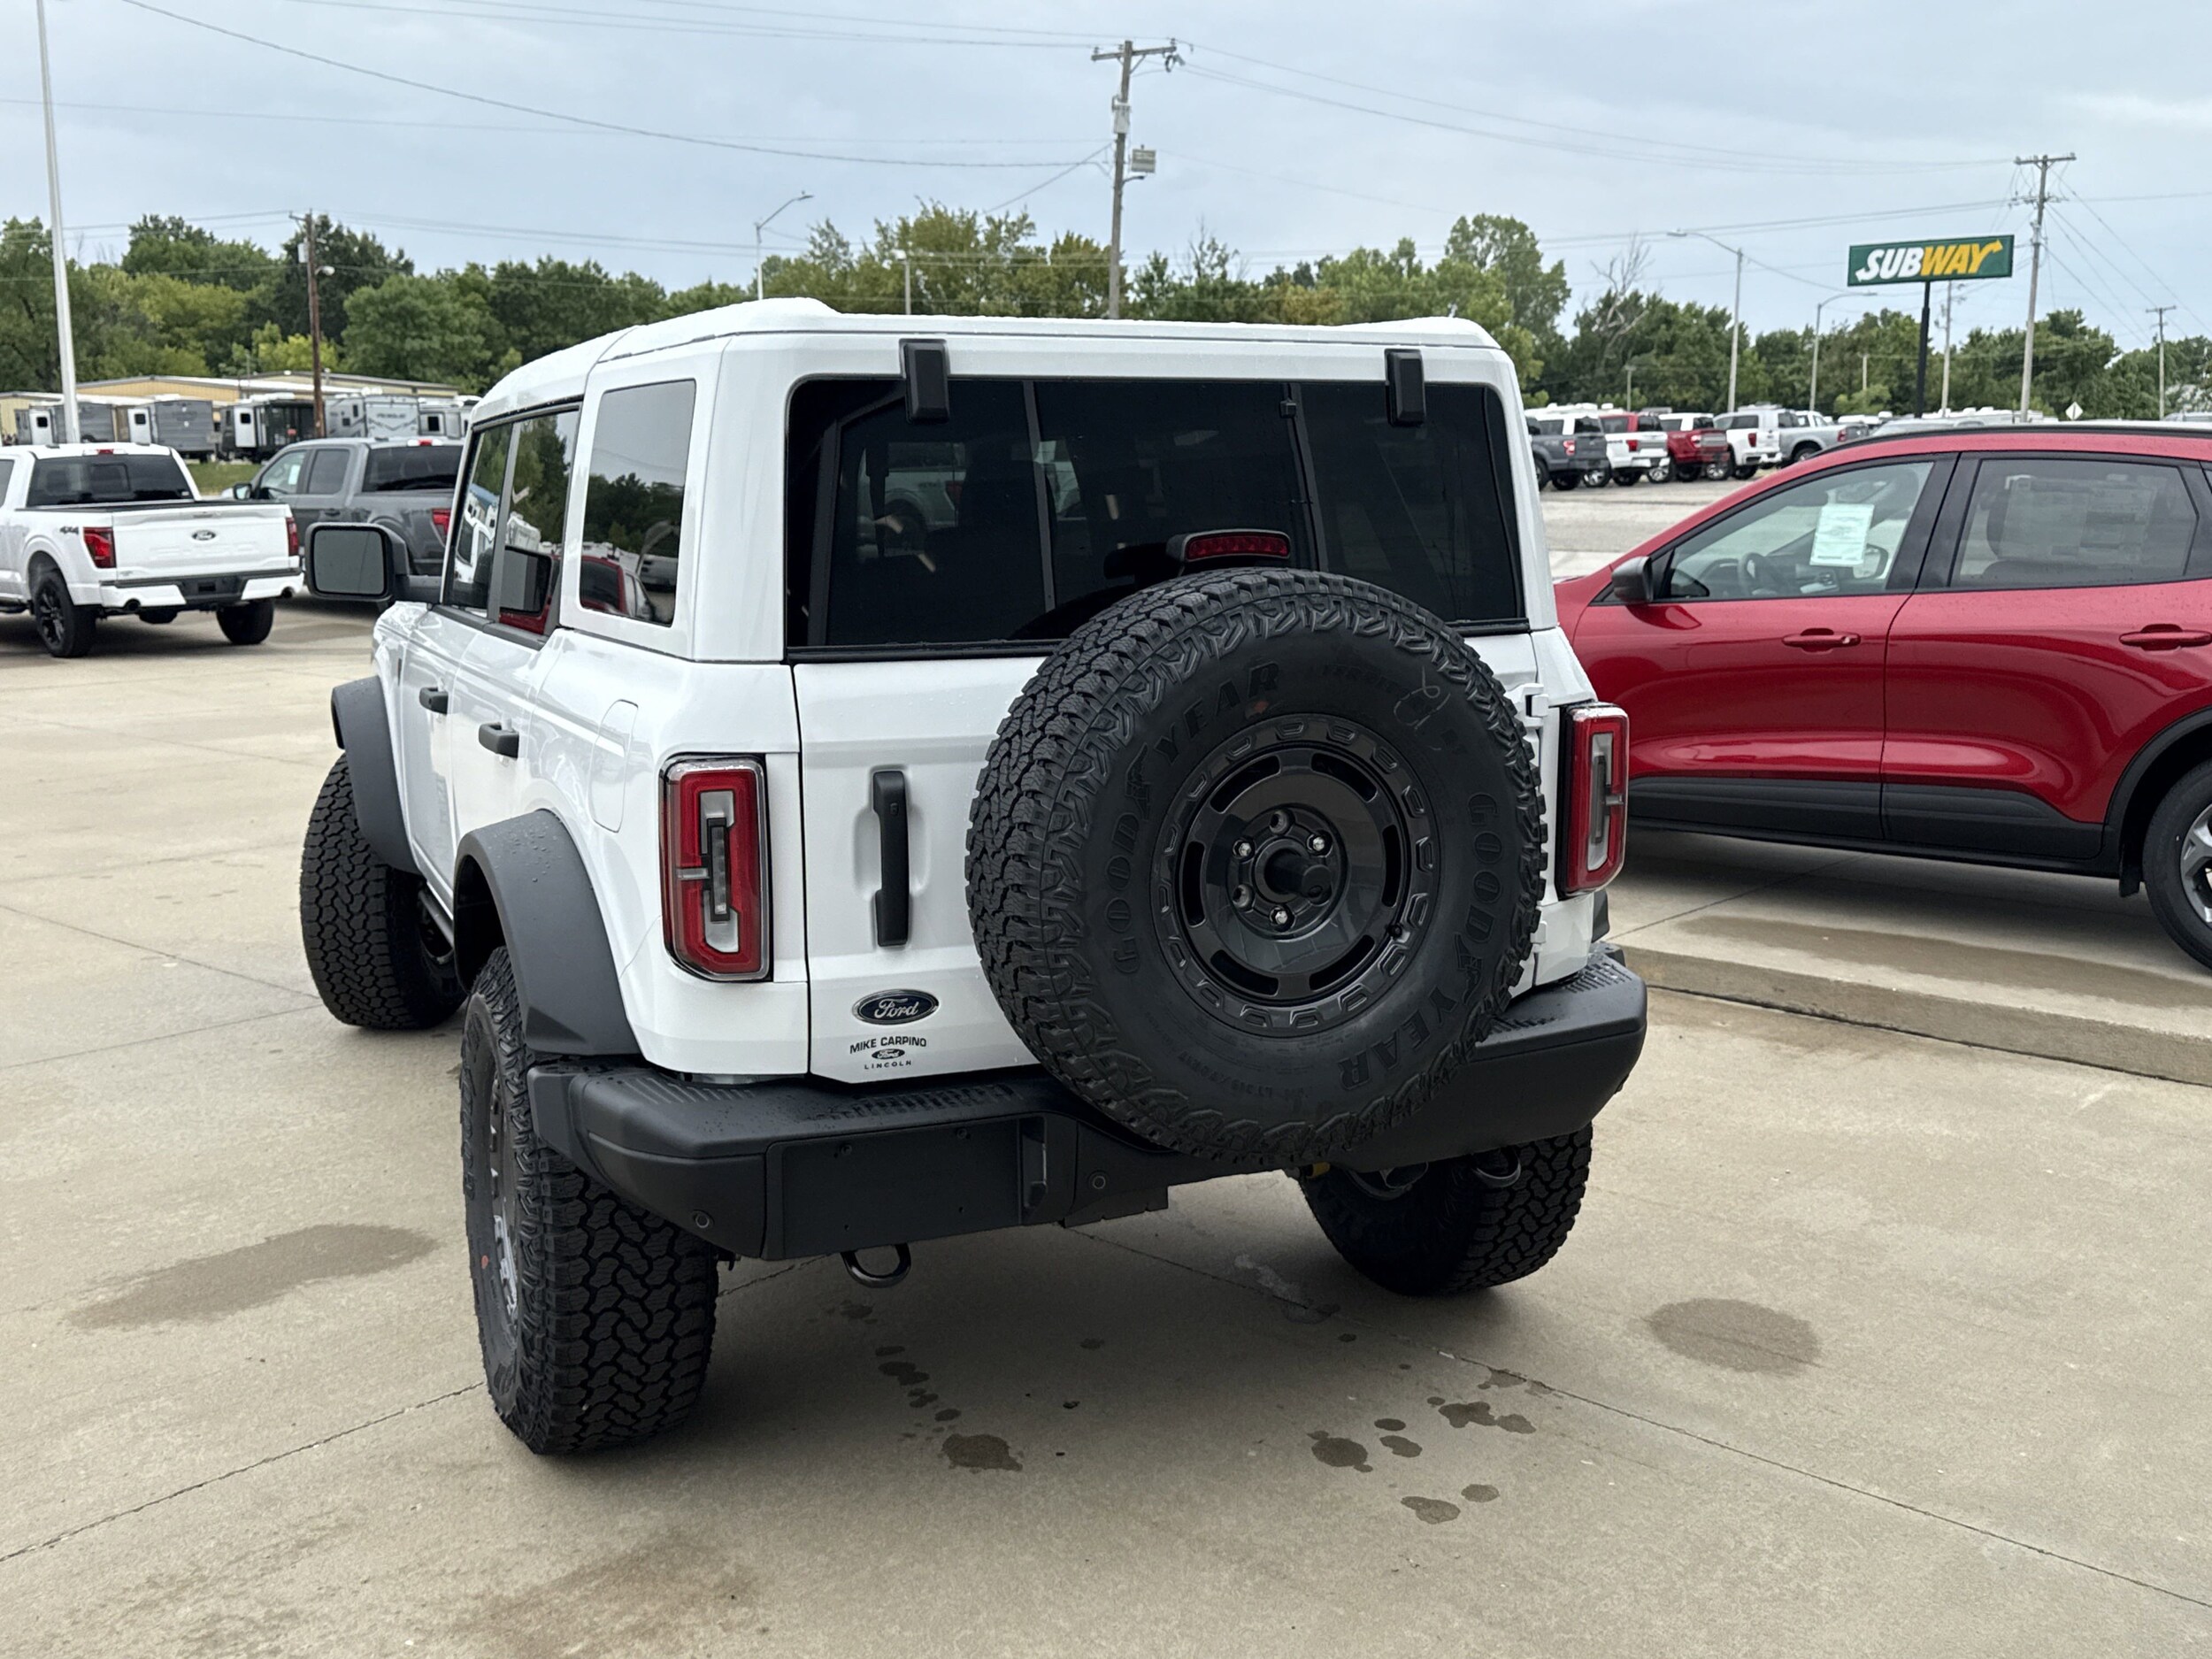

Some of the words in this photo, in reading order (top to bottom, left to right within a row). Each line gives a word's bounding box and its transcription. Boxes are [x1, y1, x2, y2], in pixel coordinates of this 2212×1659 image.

[1855, 239, 2003, 282] SUBWAY
[873, 997, 920, 1018] Ford
[849, 1039, 877, 1054] MIKE
[880, 1036, 927, 1047] CARPINO
[864, 1060, 911, 1070] LINCOLN
